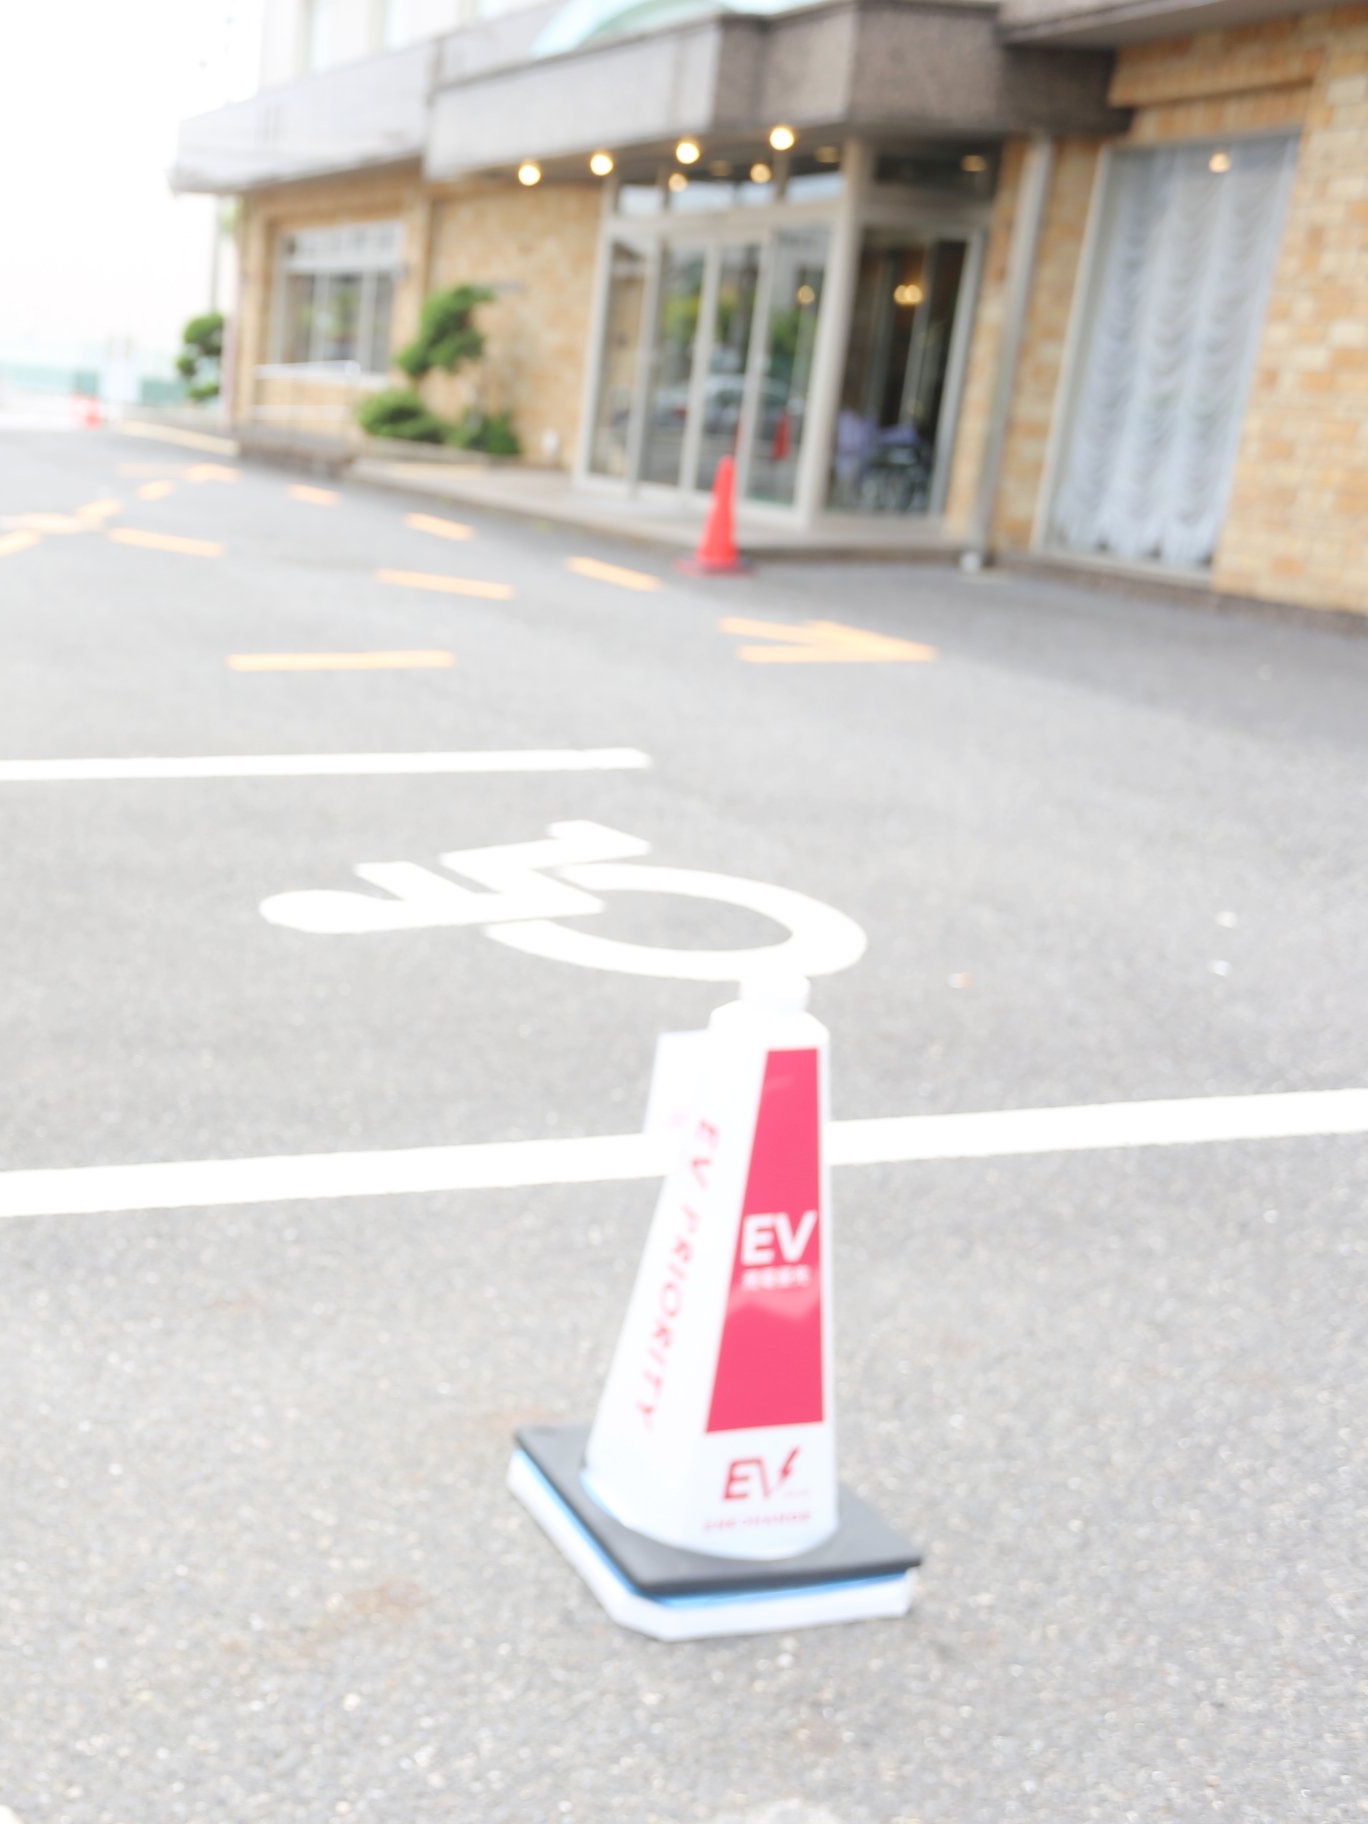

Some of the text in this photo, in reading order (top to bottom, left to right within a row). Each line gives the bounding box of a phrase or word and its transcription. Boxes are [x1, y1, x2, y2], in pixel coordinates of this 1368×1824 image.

[741, 1209, 818, 1266] EV
[636, 1203, 699, 1430] PRIORITY
[723, 1446, 800, 1501] EV
